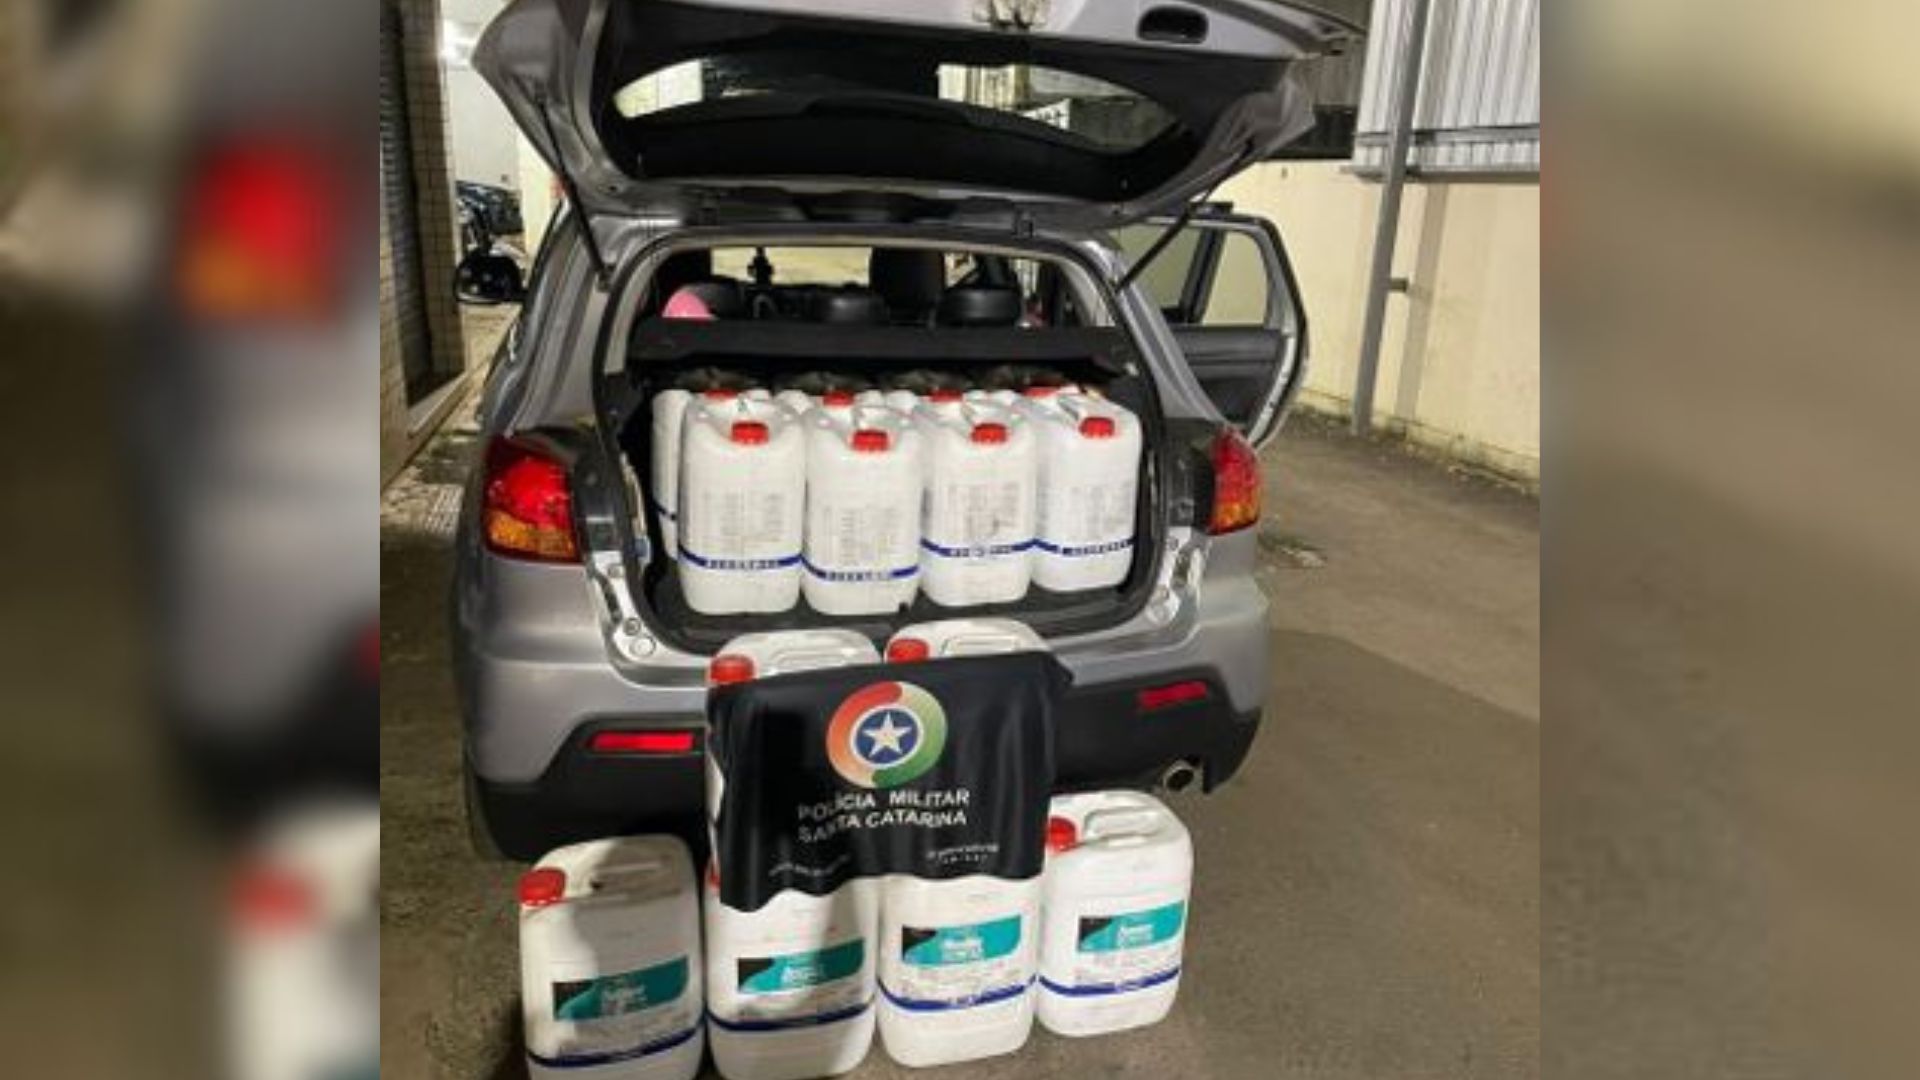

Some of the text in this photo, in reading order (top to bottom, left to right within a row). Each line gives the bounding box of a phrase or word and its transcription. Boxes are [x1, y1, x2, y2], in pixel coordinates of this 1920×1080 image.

[888, 788, 970, 806] MILITAR
[799, 809, 967, 842] SANTA CATARINA
